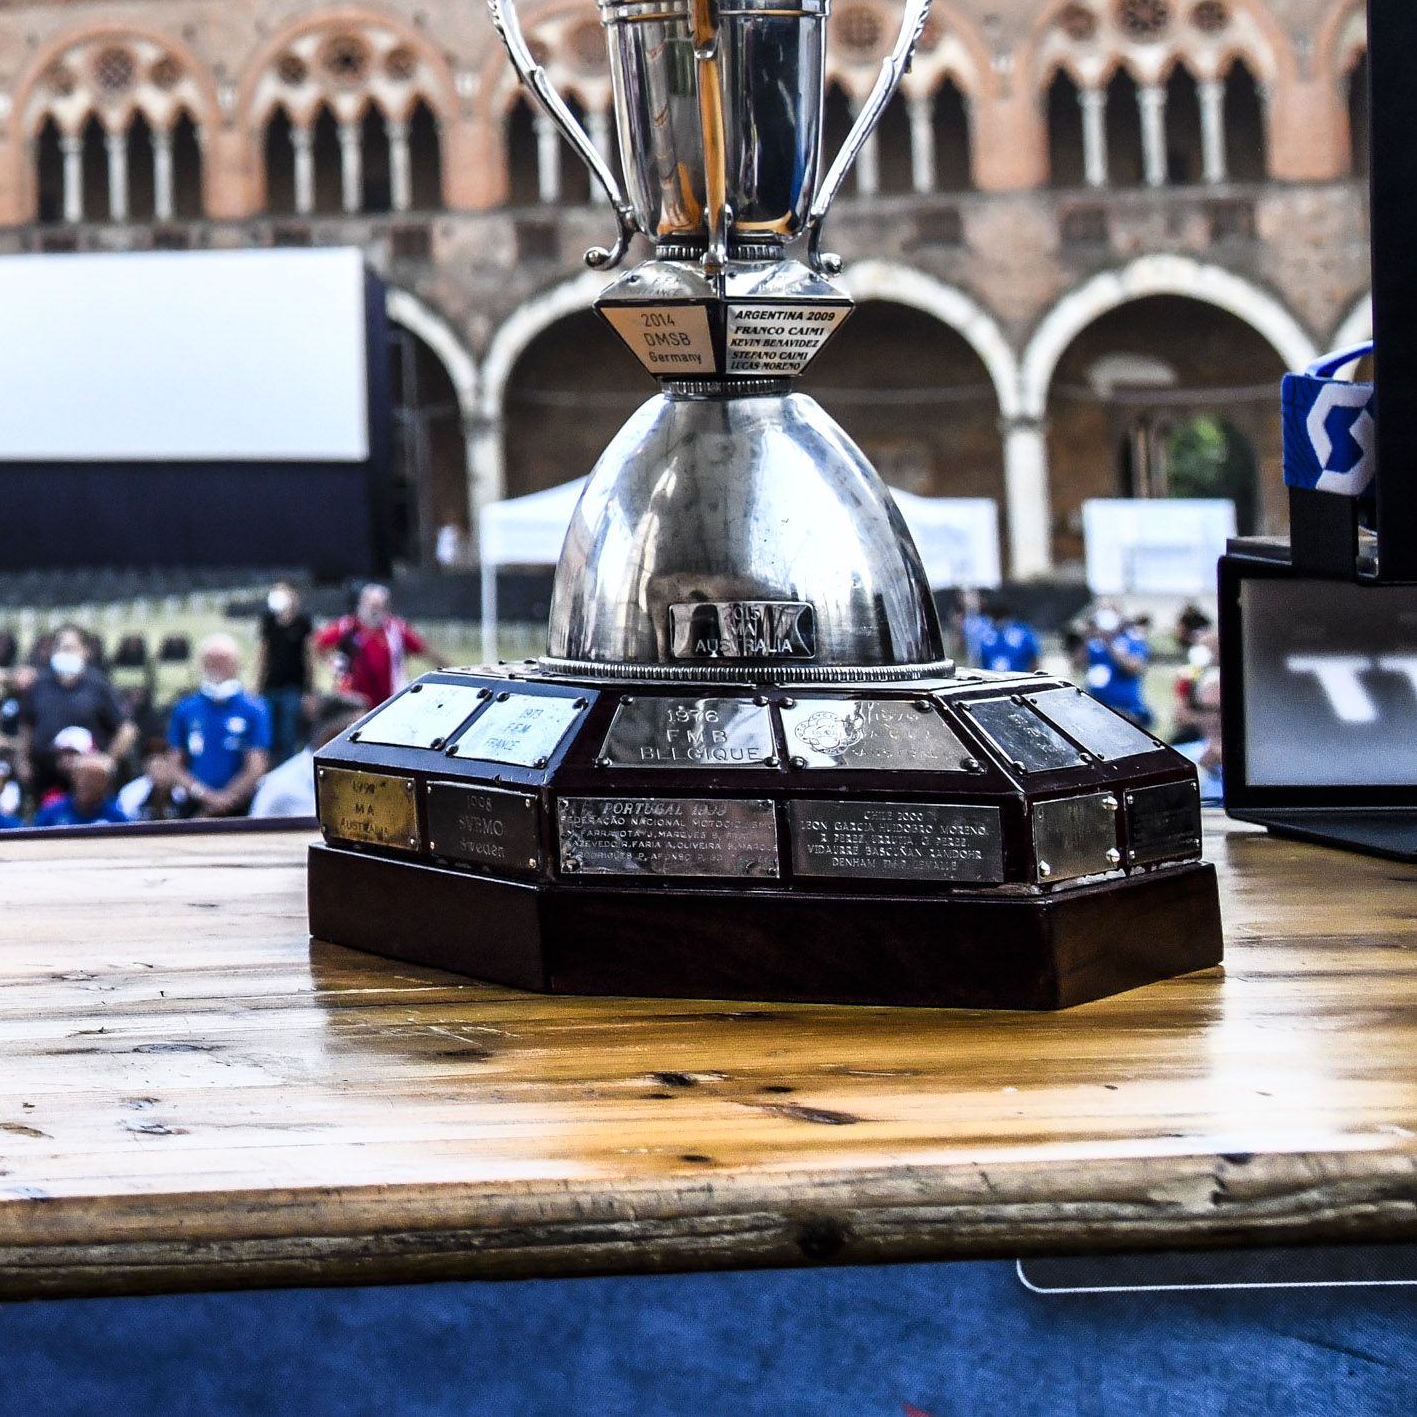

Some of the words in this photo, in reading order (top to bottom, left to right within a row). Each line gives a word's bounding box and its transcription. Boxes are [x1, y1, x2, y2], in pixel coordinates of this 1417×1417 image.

[640, 313, 676, 328] 2014
[734, 310, 805, 322] ARGENTINA
[806, 311, 836, 322] 2009
[734, 325, 784, 337] FRANCO
[787, 326, 825, 337] CAIMI
[644, 333, 691, 347] DMSB
[730, 338, 762, 348] KEVIN
[763, 339, 820, 348] BENAVIDEZ
[649, 351, 702, 365] Germany
[731, 350, 777, 361] STEFANO
[778, 351, 809, 361] CAIMI
[730, 360, 760, 370] LUCAS
[763, 361, 802, 371] MORENO
[695, 638, 794, 653] AUSTRALIA
[668, 708, 719, 724] 1976
[484, 738, 521, 752] FRANCE
[639, 746, 764, 762] BELGIQUE
[602, 801, 684, 816] PORTUGAL
[561, 814, 626, 829] FEDERAÇÃO
[631, 817, 686, 828] NACIONAL
[863, 810, 894, 822] CHILE
[897, 811, 924, 822] 2000
[832, 857, 876, 868] DENHAM
